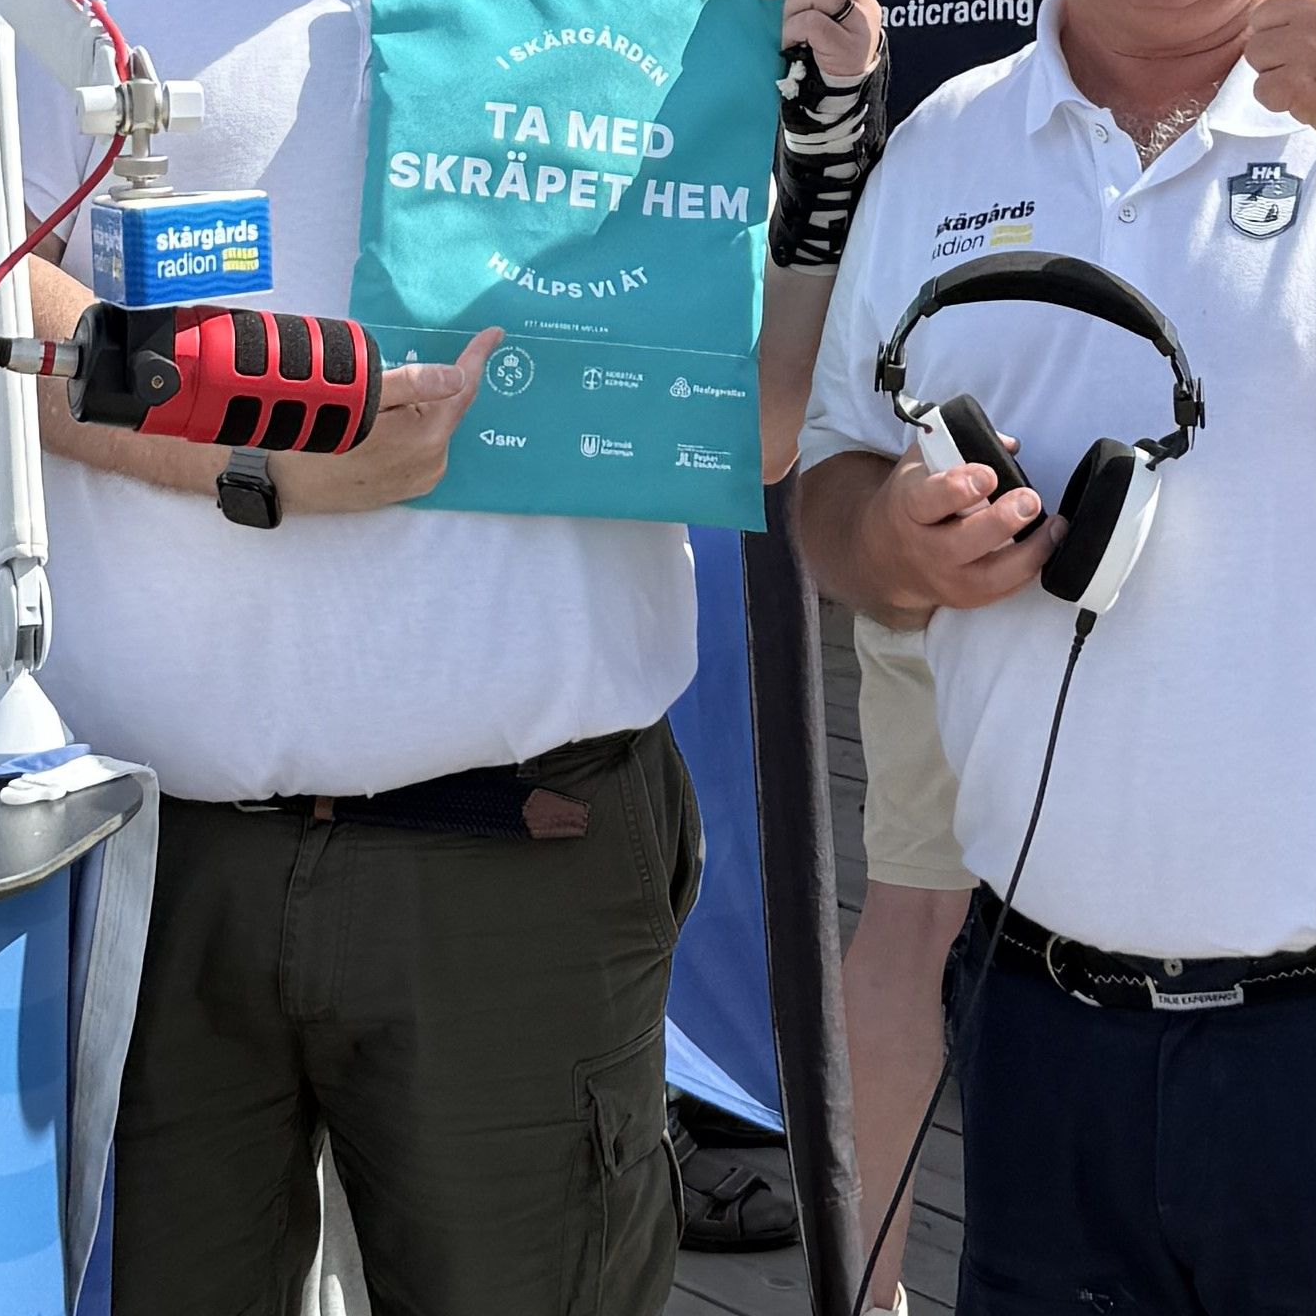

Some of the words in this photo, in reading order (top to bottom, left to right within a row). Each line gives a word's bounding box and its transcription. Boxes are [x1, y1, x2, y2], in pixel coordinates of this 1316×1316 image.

[509, 25, 669, 87] SKÄRGÅRDEN
[485, 101, 551, 145] TA
[567, 110, 675, 159] MED
[388, 150, 633, 212] SKRÄPET
[642, 179, 750, 223] HEM
[156, 219, 259, 251] skärgårds
[157, 252, 217, 279] radion
[487, 251, 583, 299] HJÄLPS
[588, 279, 617, 298] VI
[495, 434, 527, 448] SRV
